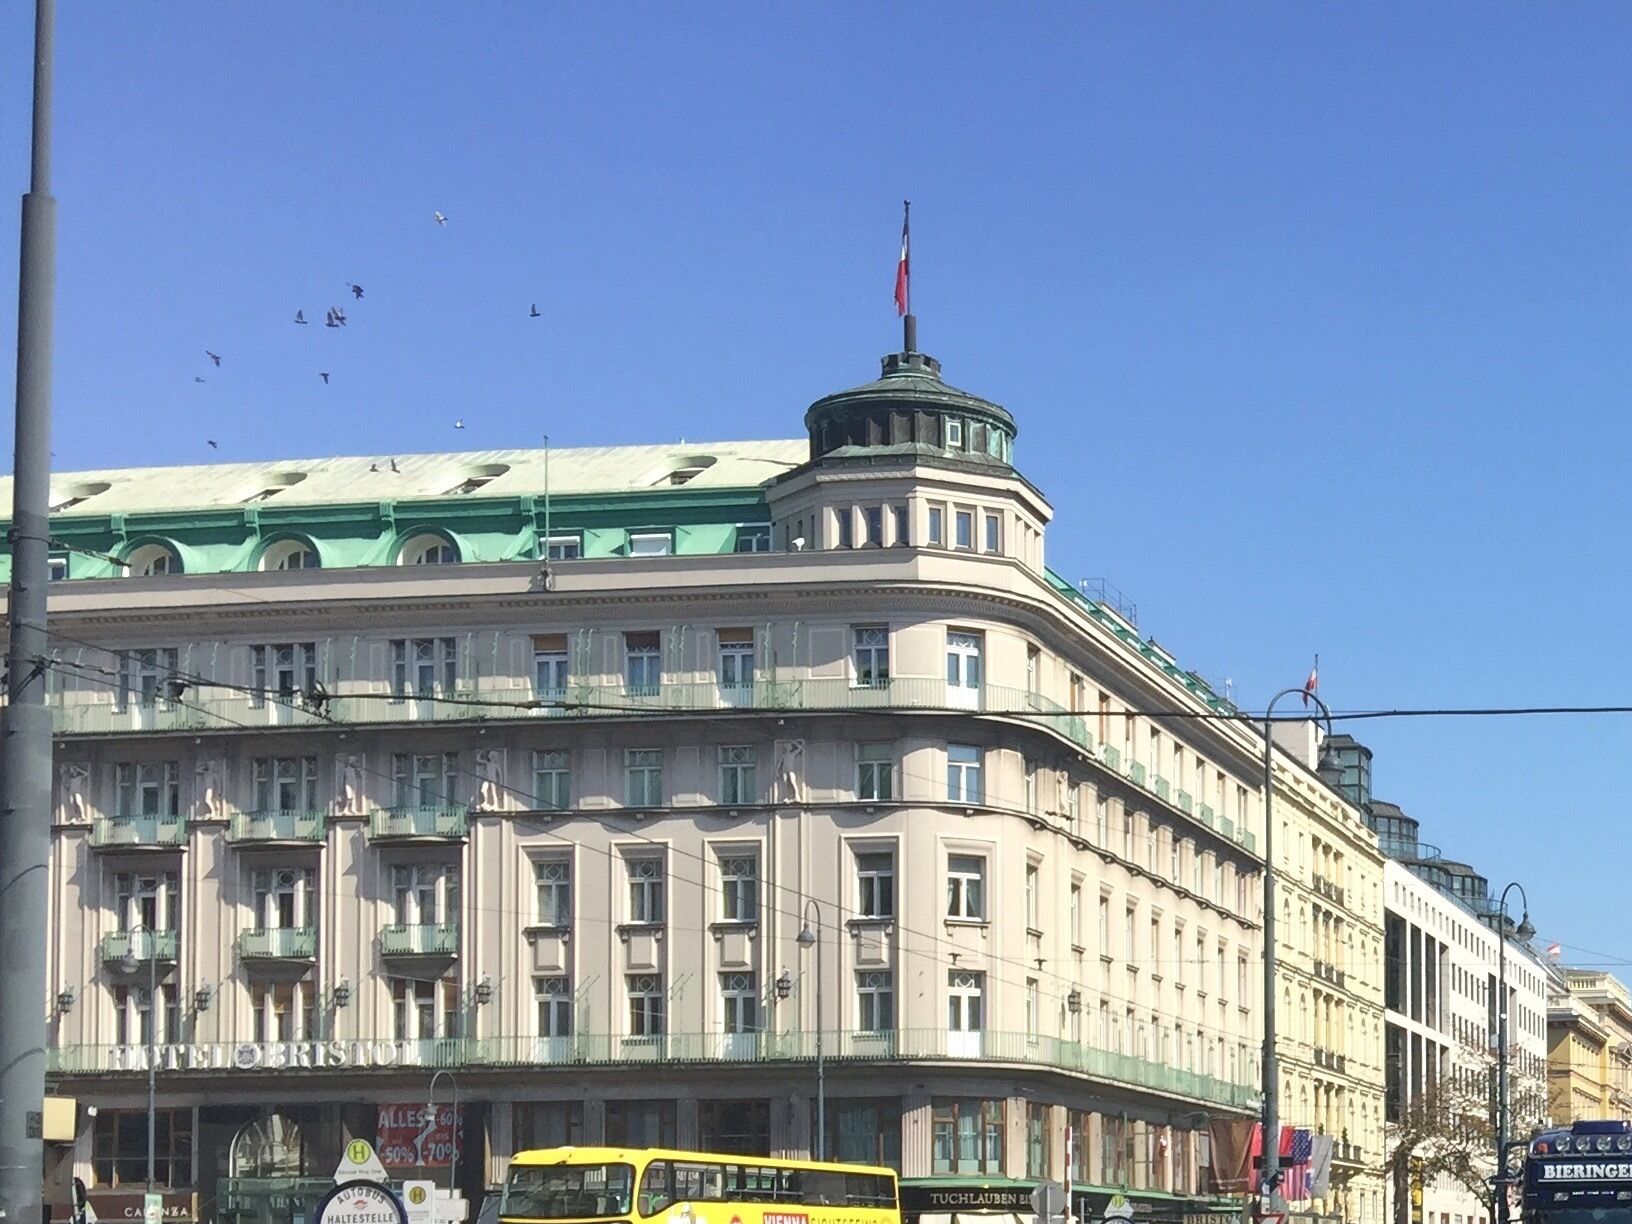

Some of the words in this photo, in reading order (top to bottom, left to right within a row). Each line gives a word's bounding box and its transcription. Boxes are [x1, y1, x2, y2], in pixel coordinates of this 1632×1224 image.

[109, 1043, 234, 1072] HOTEL
[267, 1040, 422, 1069] BRISTOL
[378, 1110, 425, 1129] ALLES
[353, 1145, 365, 1161] H
[380, 1147, 415, 1163] -50%
[424, 1142, 460, 1161] -70%
[337, 1187, 386, 1204] AUTOBUS
[930, 1192, 1017, 1205] TUCHLAUBEN
[124, 1206, 189, 1218] CANZA
[327, 1212, 393, 1224] HALTESTELLE
[1186, 1214, 1242, 1224] BRISTO
